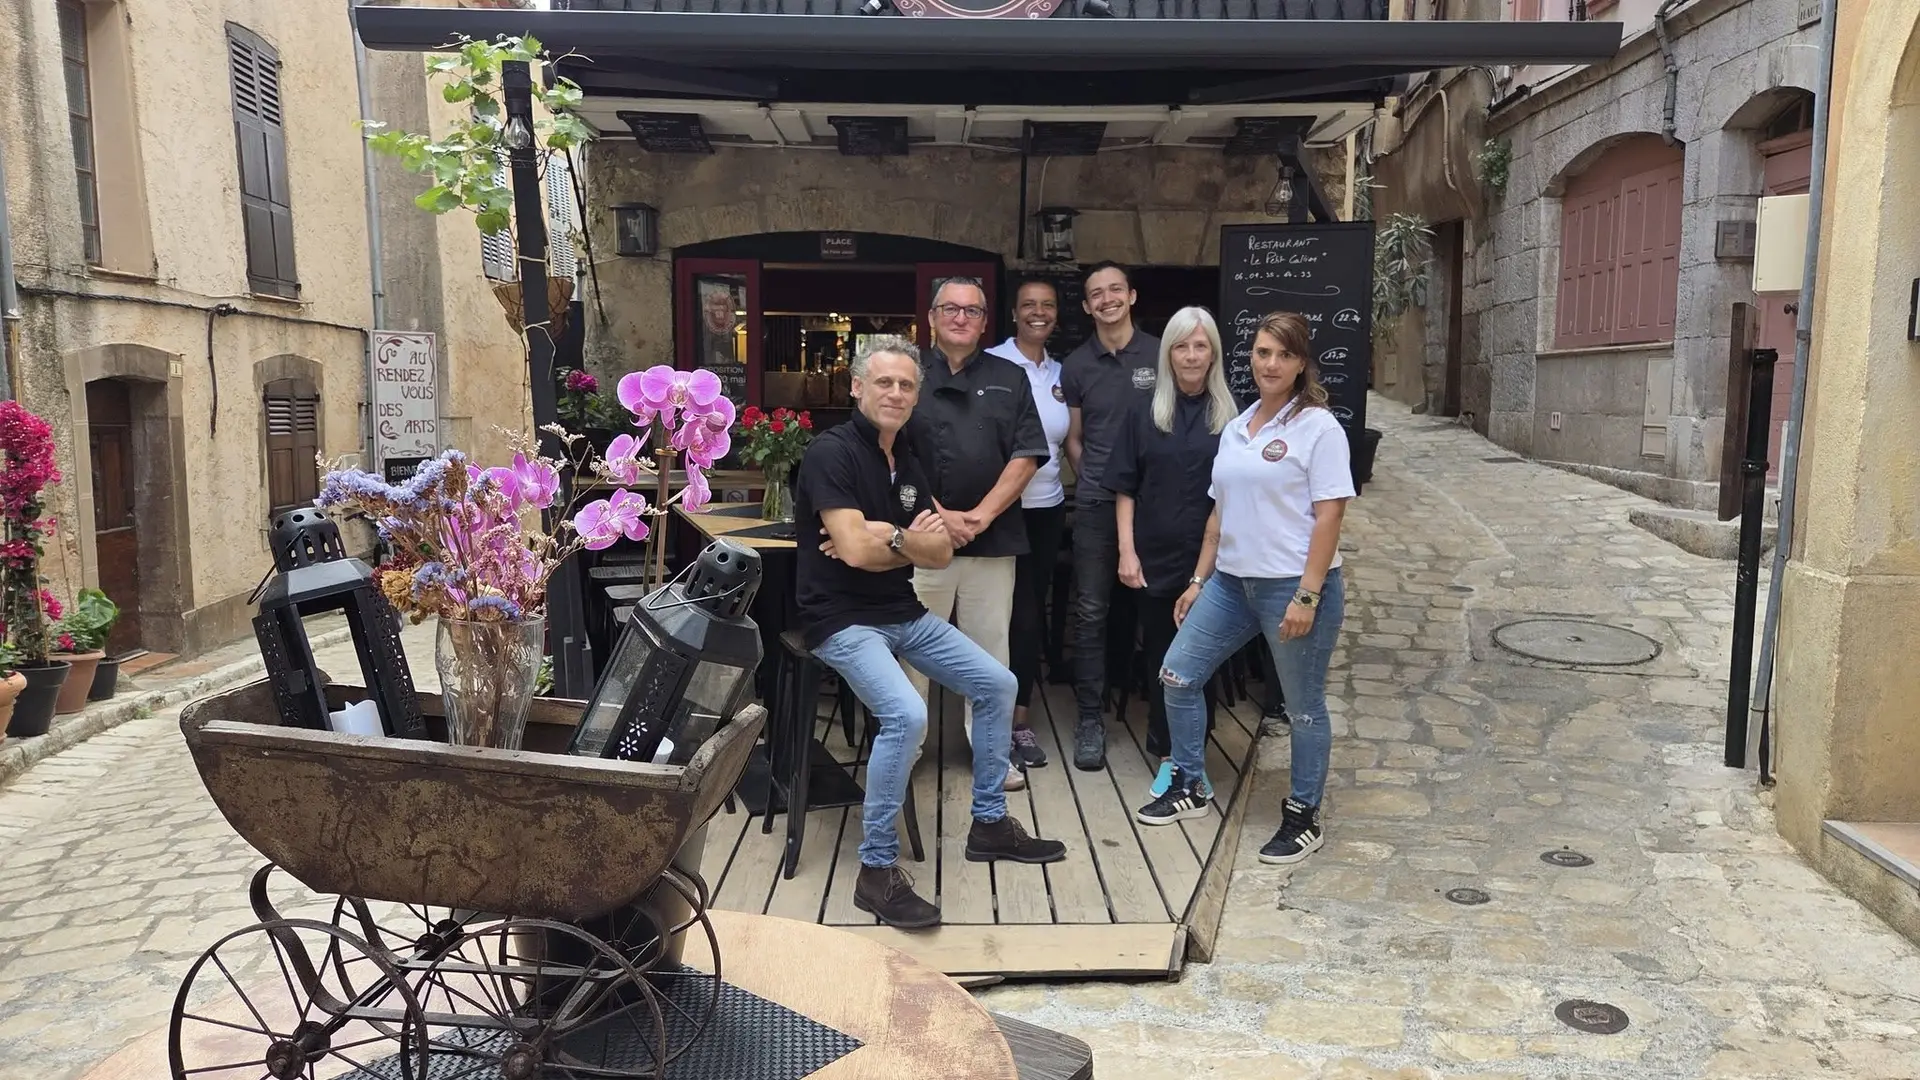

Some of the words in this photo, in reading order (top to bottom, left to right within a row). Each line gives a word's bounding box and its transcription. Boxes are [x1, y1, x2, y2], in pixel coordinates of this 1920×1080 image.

[825, 237, 853, 245] PLACE
[1248, 235, 1319, 250] RESTAURANT
[1250, 253, 1261, 265] Le
[409, 351, 427, 365] AU
[376, 368, 424, 382] RENDEZ
[401, 386, 434, 400] VOUS
[379, 404, 403, 417] DES
[404, 419, 435, 434] ARTS
